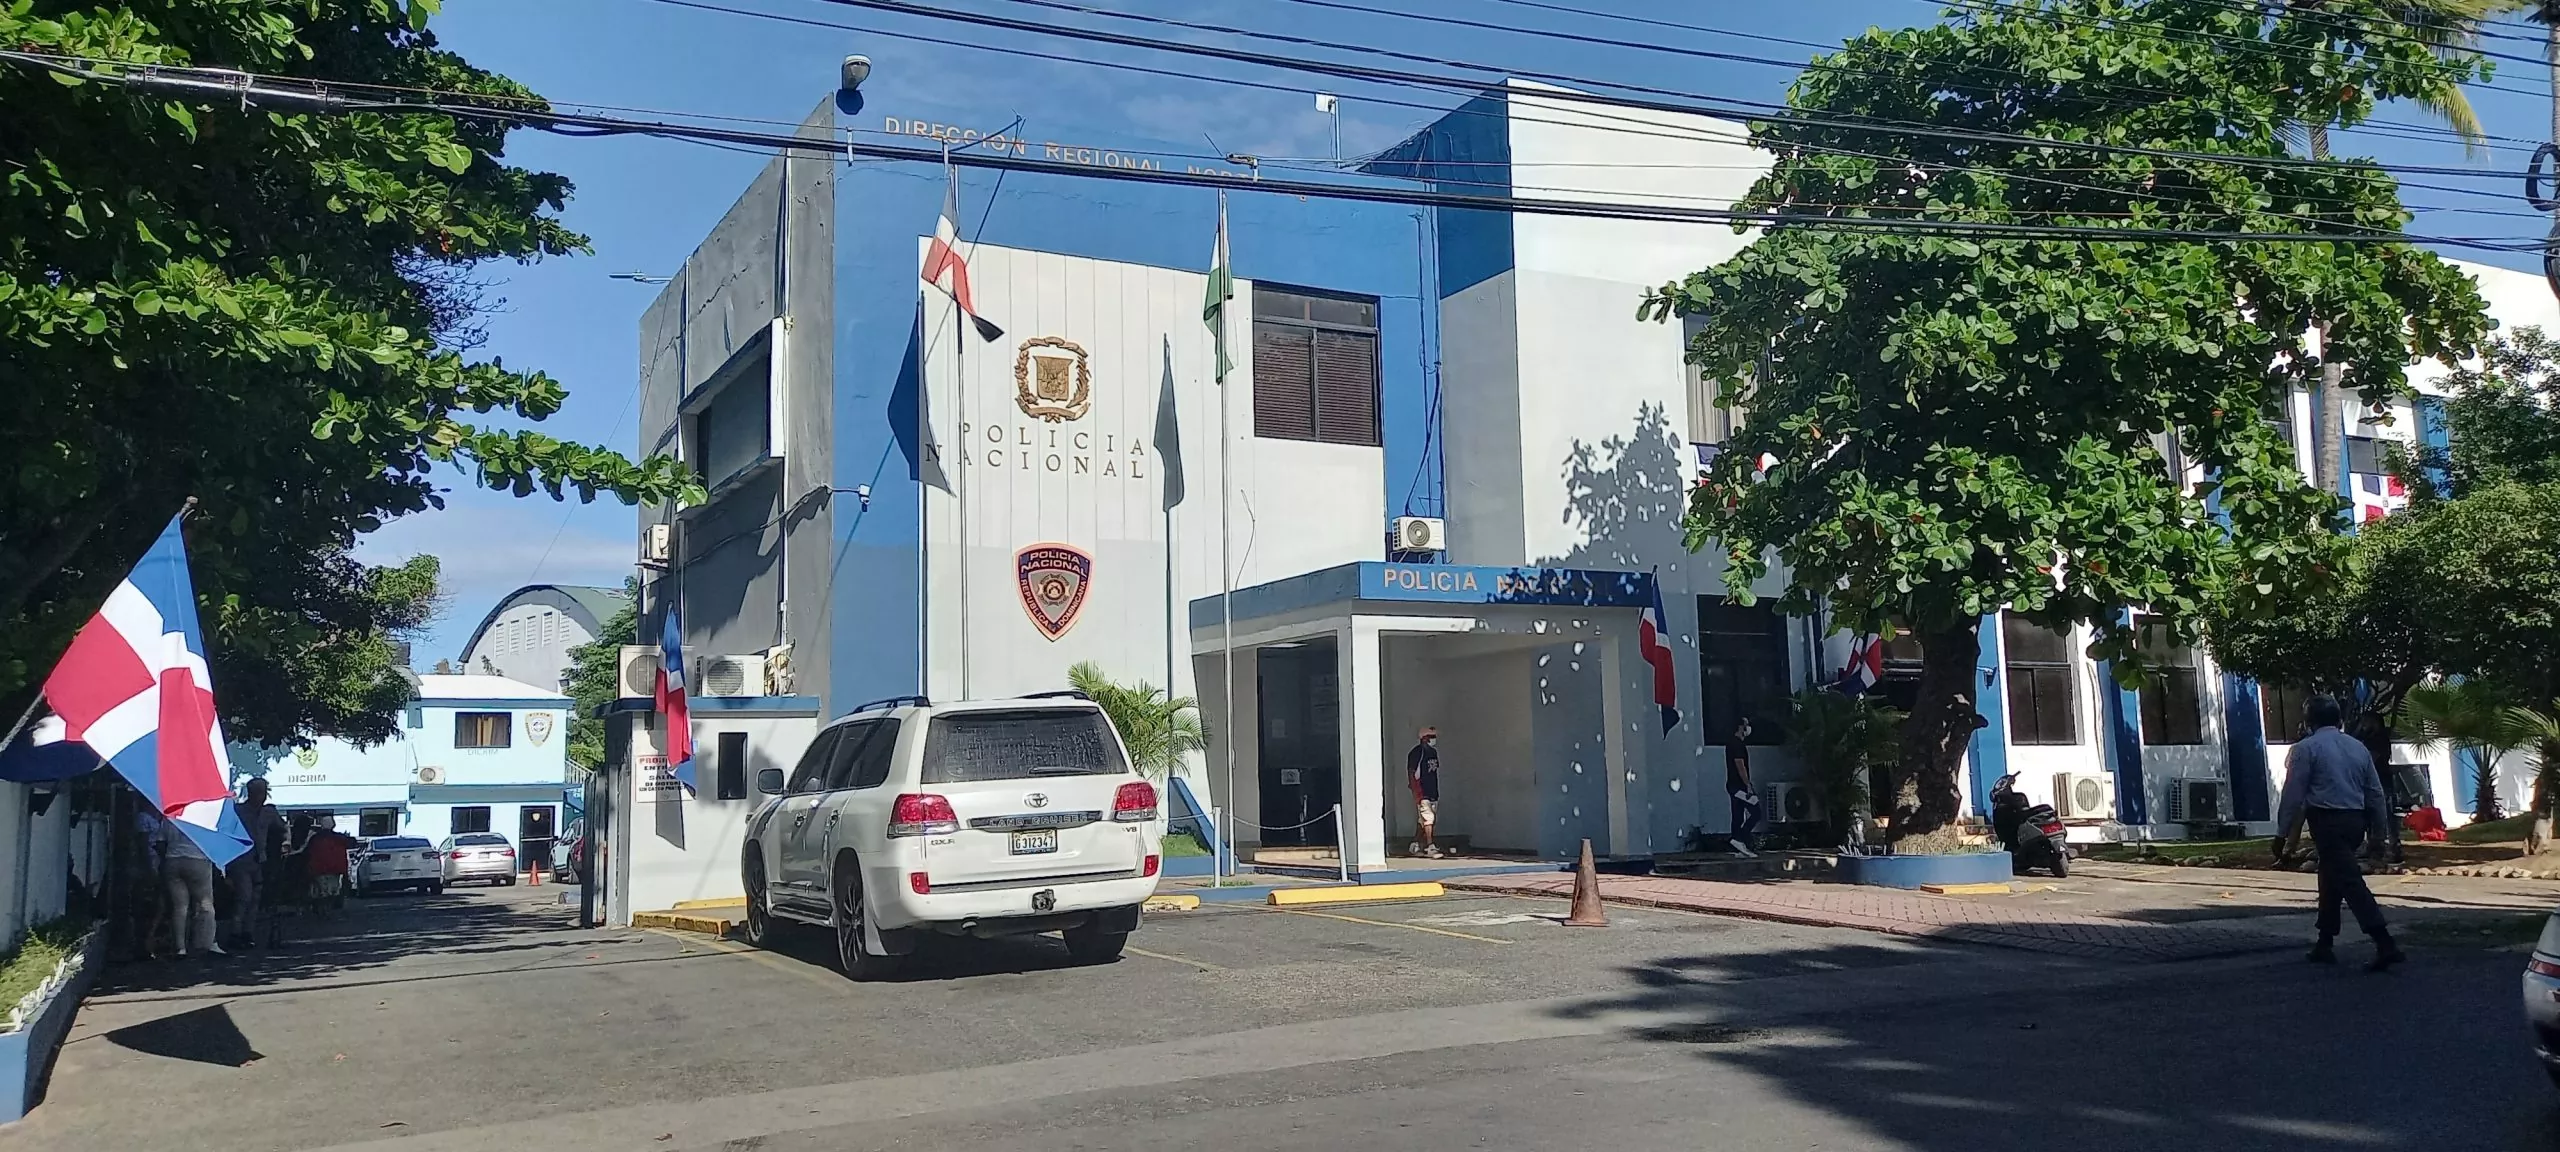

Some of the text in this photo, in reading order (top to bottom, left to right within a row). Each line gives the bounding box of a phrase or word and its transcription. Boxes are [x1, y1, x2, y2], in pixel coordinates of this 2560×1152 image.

[885, 116, 1025, 155] DIRECCION
[959, 423, 1144, 456] POLICIA
[925, 443, 1144, 479] NACIONAL
[1020, 559, 1088, 578] NACIONAL
[1030, 550, 1080, 565] POLICIA
[1384, 568, 1478, 592] POLICIA
[1020, 579, 1049, 628] REPUBLICA
[1058, 580, 1087, 627] DOMINICANA
[1015, 836, 1054, 849] G312347
